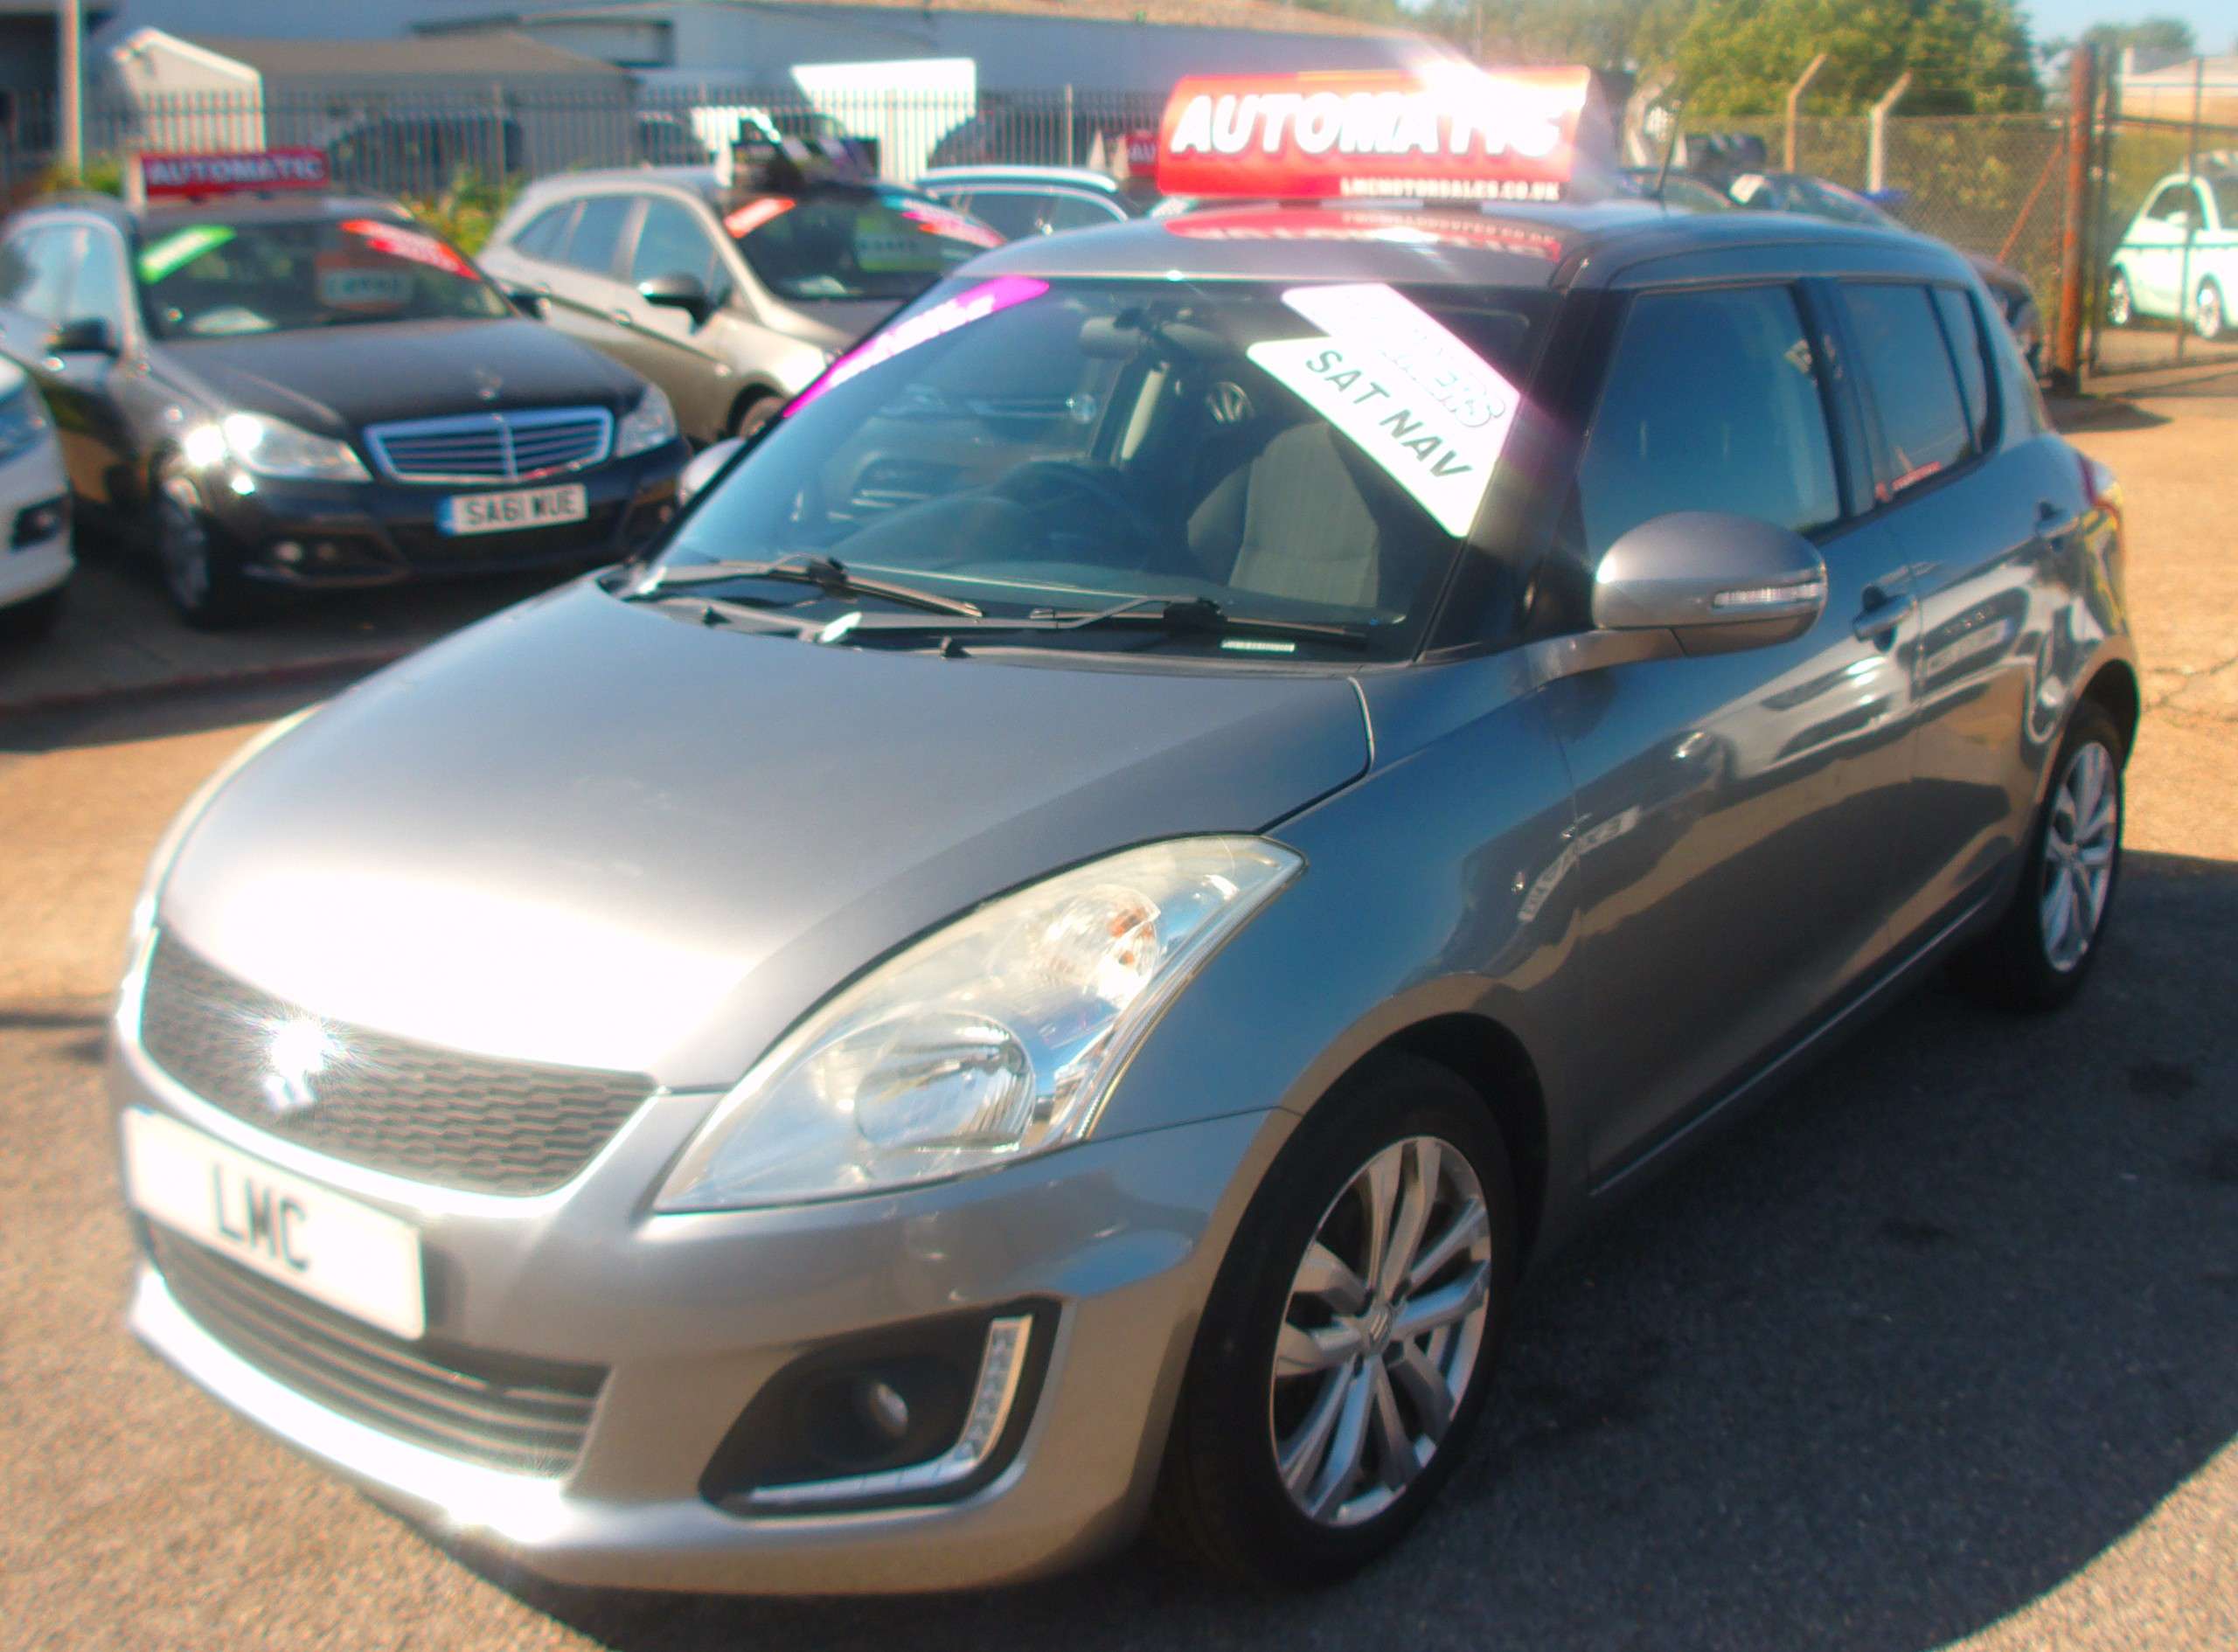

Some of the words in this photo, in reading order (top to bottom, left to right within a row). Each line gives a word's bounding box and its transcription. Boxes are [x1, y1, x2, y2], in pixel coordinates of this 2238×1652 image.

[1170, 91, 1564, 156] AUTOMATIC
[149, 156, 323, 185] AUTOMATIC
[1305, 348, 1390, 406] SAT
[1379, 408, 1474, 479] NAV
[212, 1161, 309, 1274] LMC
